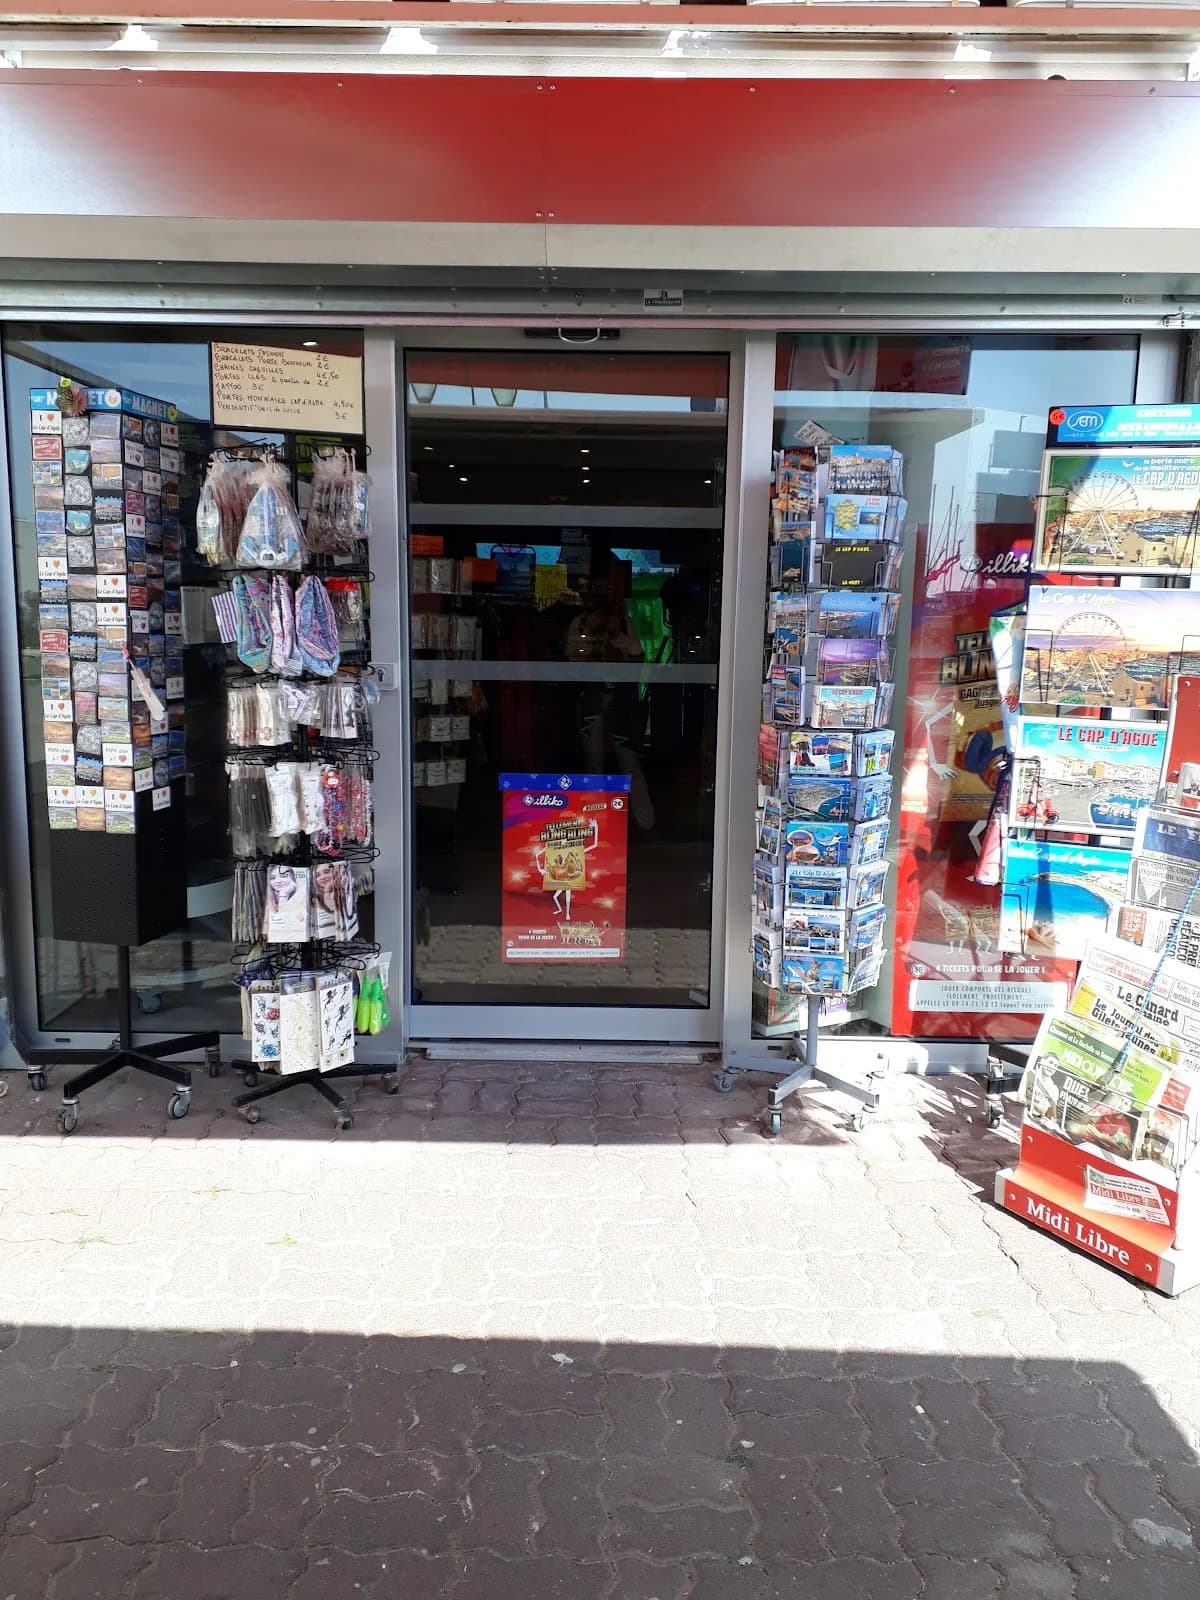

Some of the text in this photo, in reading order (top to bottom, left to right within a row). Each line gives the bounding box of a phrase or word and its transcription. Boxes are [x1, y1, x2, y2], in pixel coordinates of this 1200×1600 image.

[46, 391, 105, 406] MET
[132, 396, 167, 418] MAGNET
[1144, 471, 1164, 485] CAP
[1168, 471, 1200, 485] D'AGD
[982, 551, 1033, 573] illik
[942, 651, 997, 683] BLIN
[1057, 727, 1158, 747] LE CAP D'AGDE
[534, 795, 563, 806] illiko
[541, 828, 594, 841] BLING BLING
[1157, 823, 1177, 836] LE
[942, 964, 970, 973] TICKETS
[972, 964, 992, 973] POUR
[993, 965, 1002, 974] SE
[1005, 966, 1015, 974] LA
[1016, 966, 1040, 975] JOUER
[1117, 985, 1132, 1004] Le
[1095, 998, 1107, 1013] Le
[1091, 1184, 1114, 1199] Midi
[1116, 1190, 1142, 1205] Libre
[1027, 1196, 1130, 1266] Midi Libre
